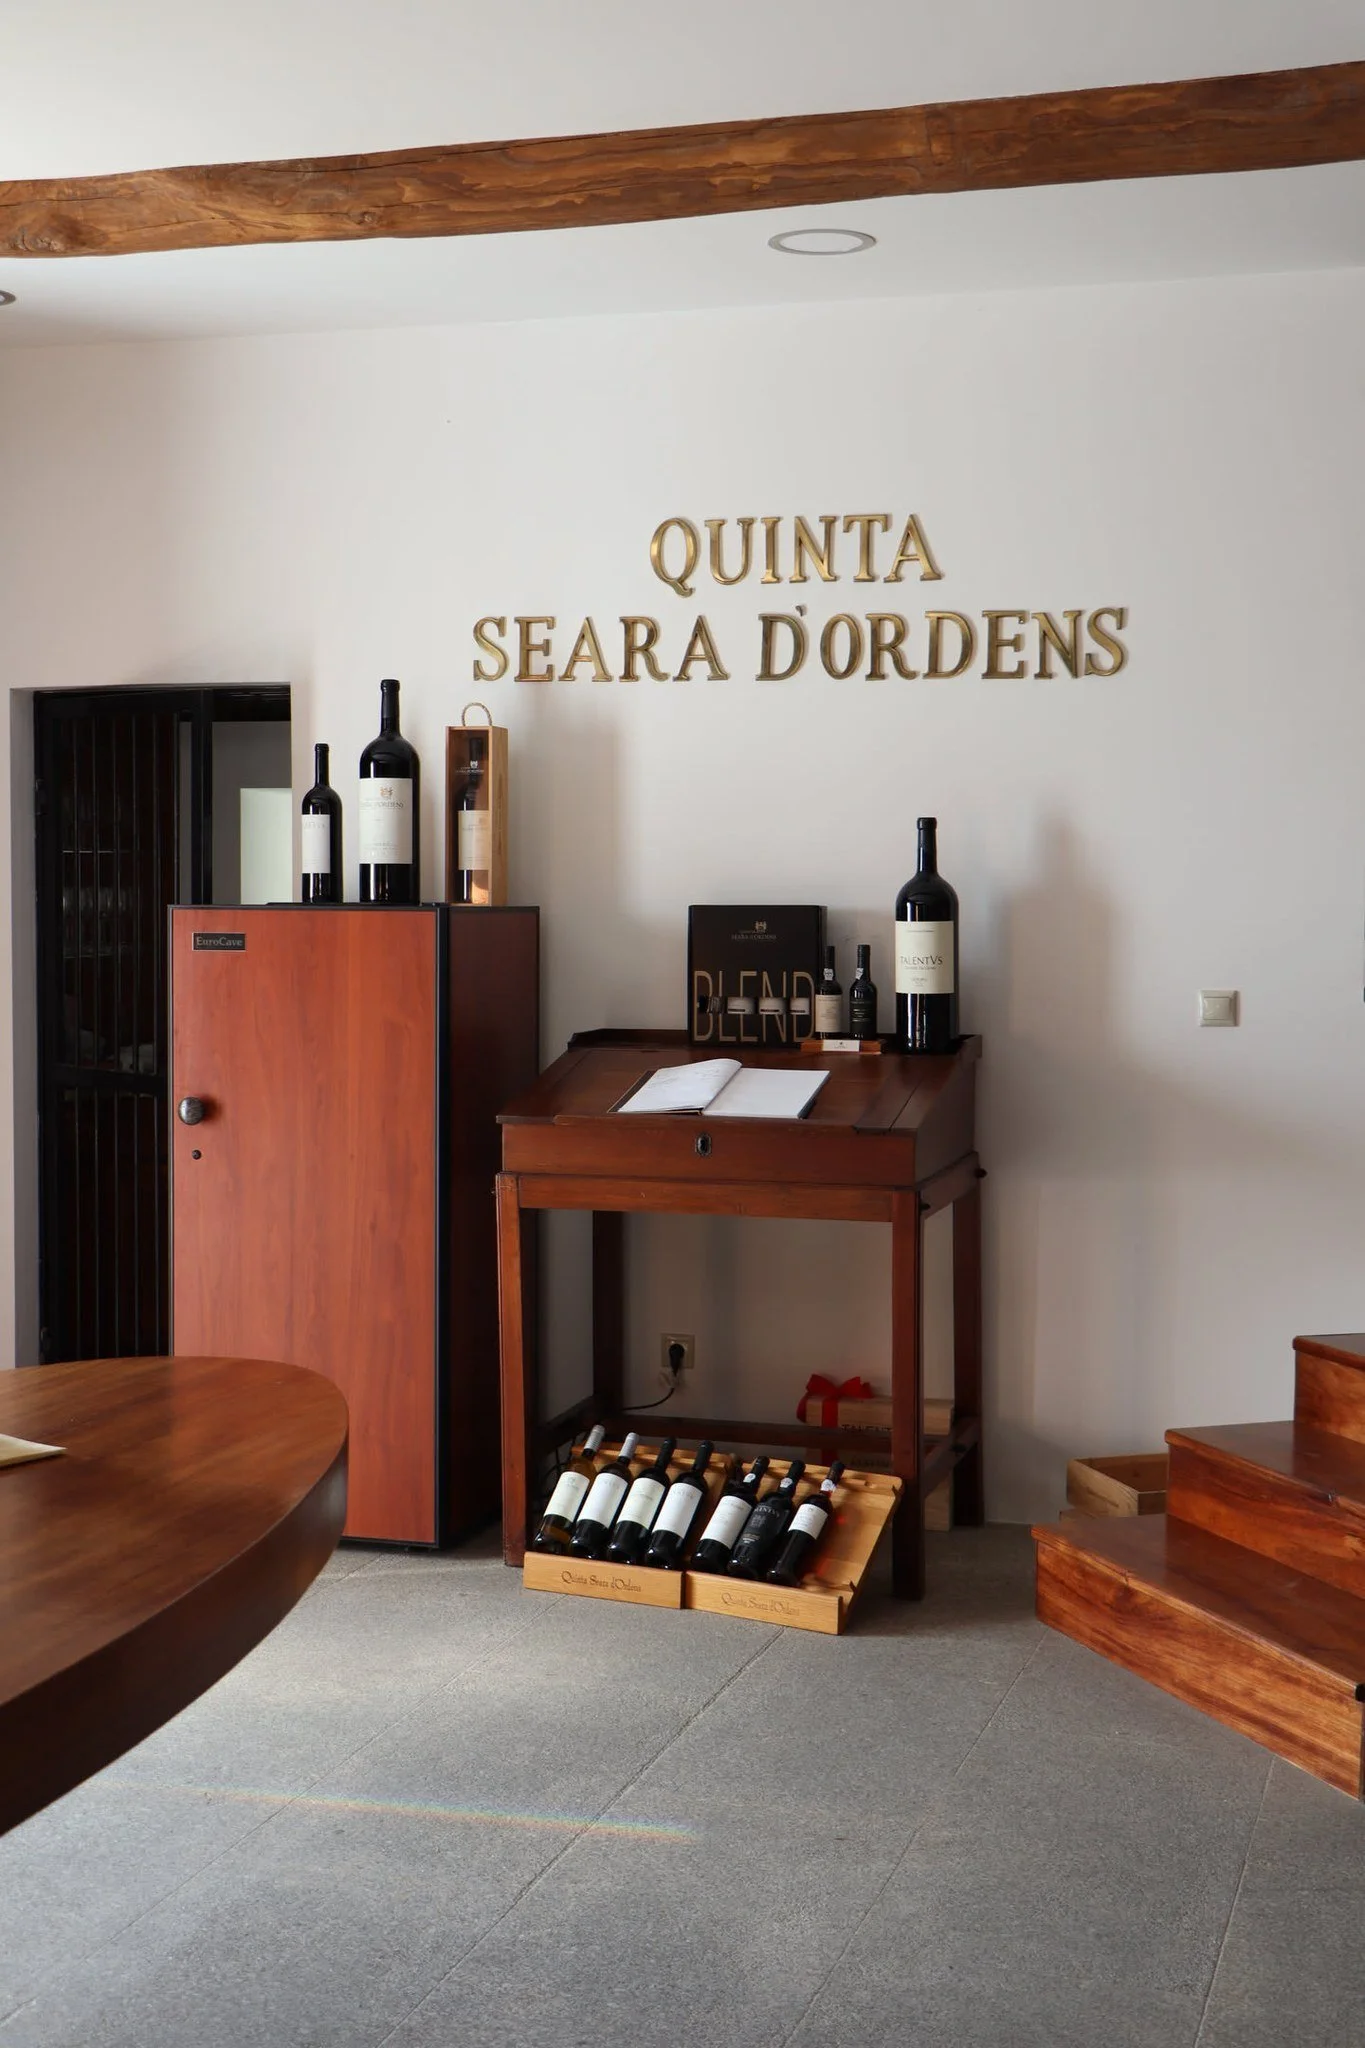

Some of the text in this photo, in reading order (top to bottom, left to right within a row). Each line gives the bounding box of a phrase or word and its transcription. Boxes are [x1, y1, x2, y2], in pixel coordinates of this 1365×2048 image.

[649, 513, 943, 597] QUINTA
[472, 614, 730, 682] SEARA
[196, 936, 243, 947] EuroCave
[693, 970, 815, 1042] BLEND
